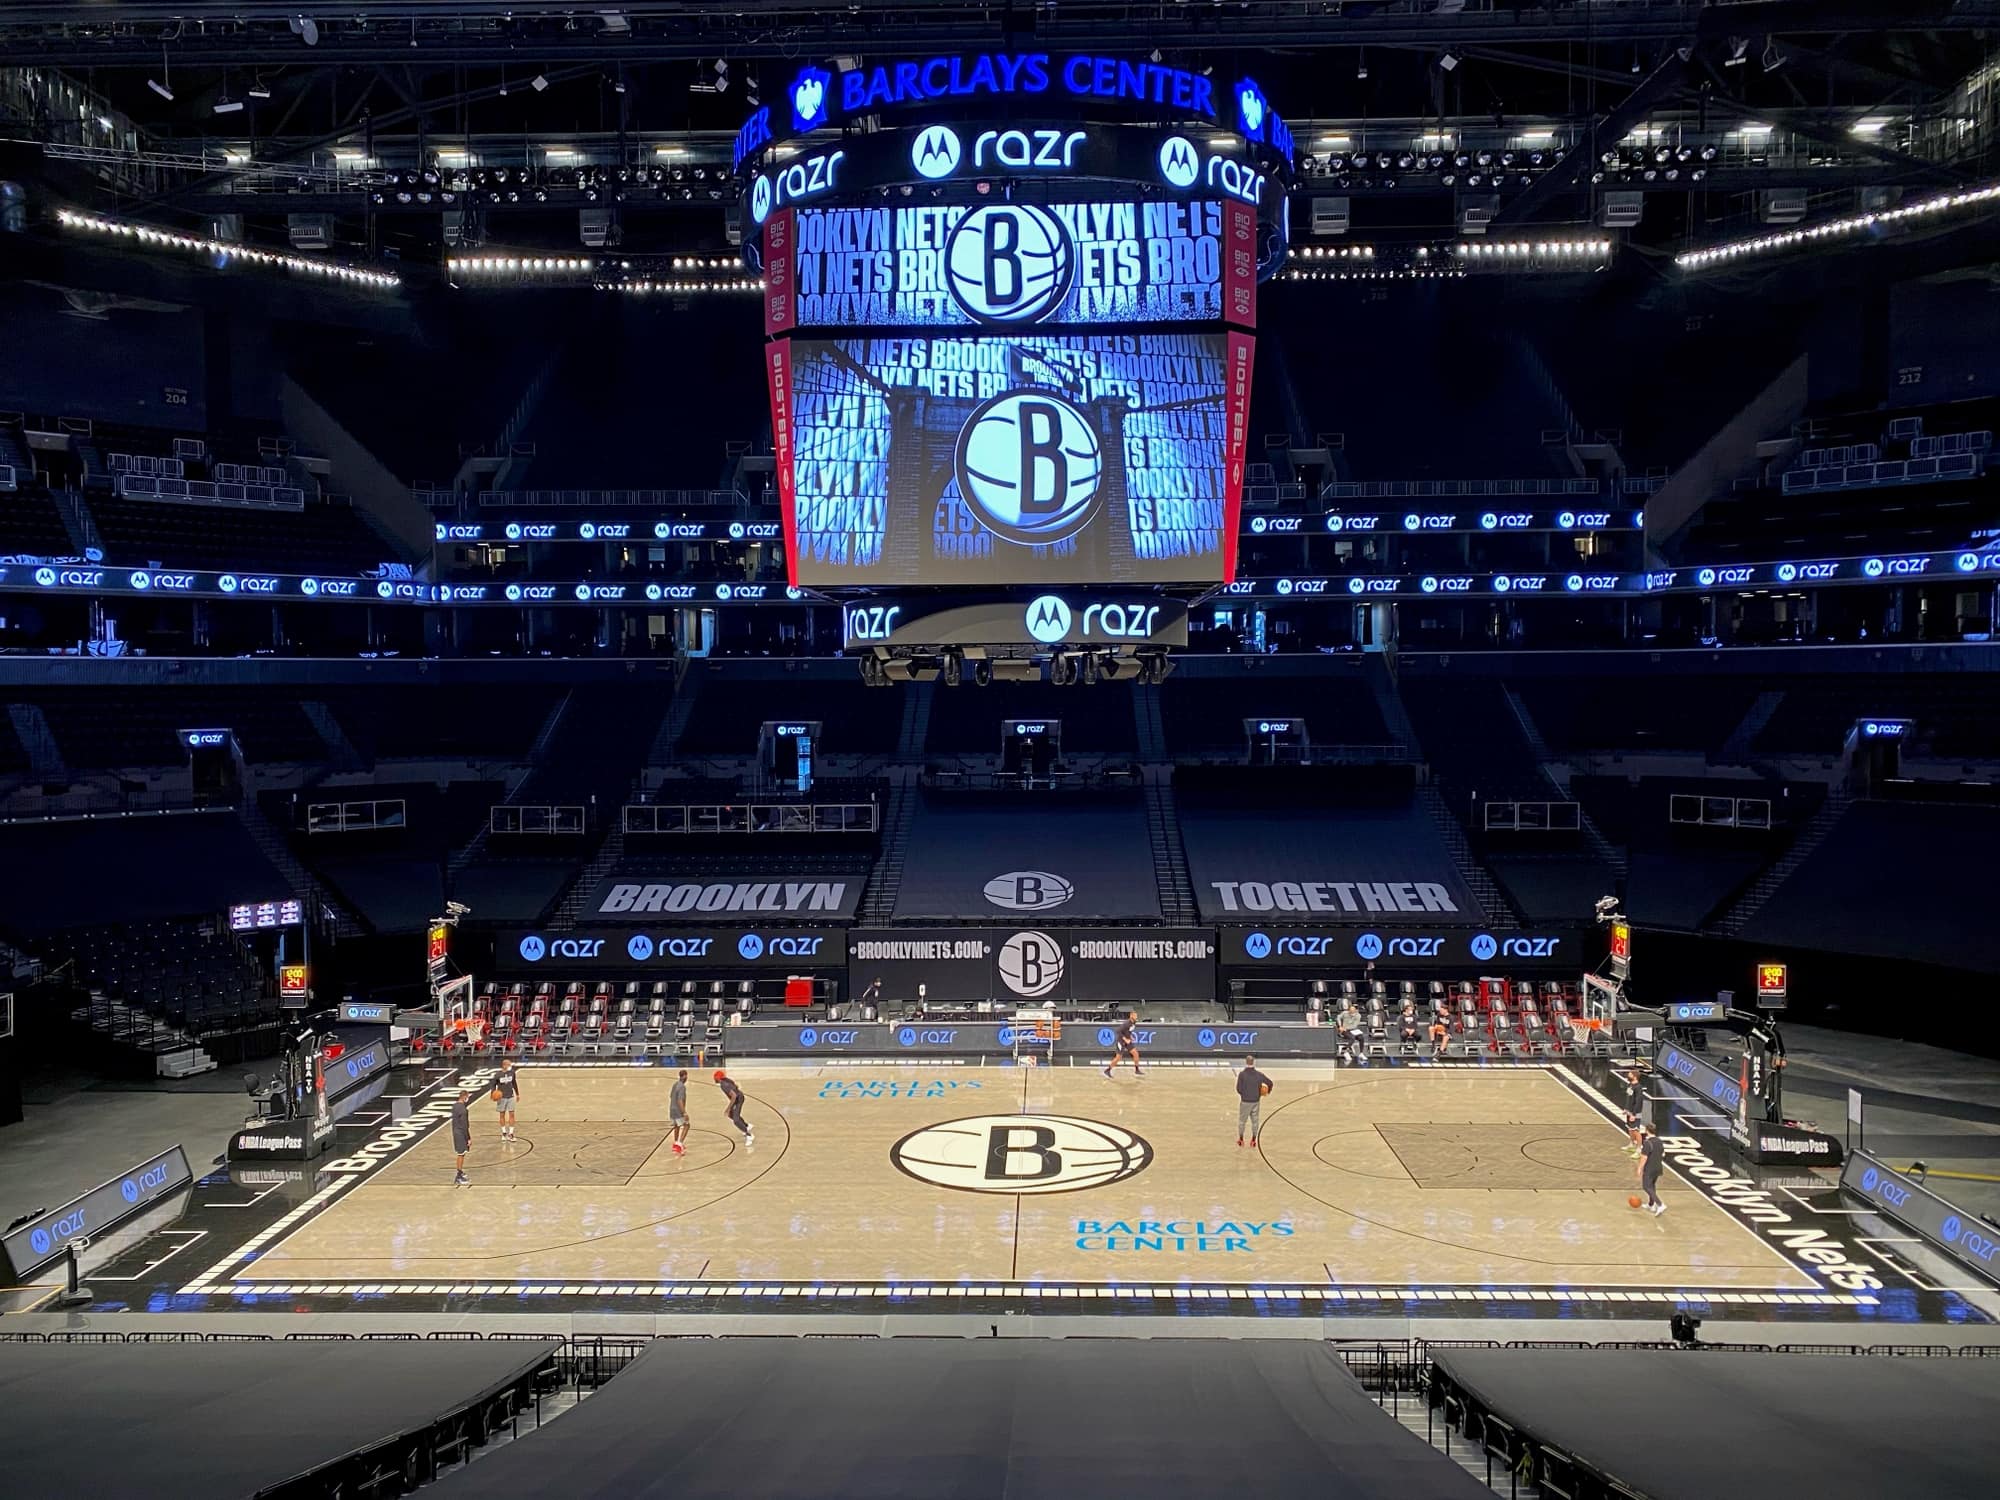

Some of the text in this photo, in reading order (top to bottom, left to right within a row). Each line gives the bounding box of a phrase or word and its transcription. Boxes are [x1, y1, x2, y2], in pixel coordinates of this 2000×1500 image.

[843, 54, 1217, 117] BARCLAYS CENTER
[974, 130, 1087, 167] razr
[776, 151, 843, 205] razr
[1207, 155, 1265, 204] razr
[1149, 235, 1220, 285] BRO
[825, 251, 892, 294] NETS
[869, 338, 926, 367] NETS
[1101, 351, 1199, 384] BROOKLYN
[165, 393, 187, 405] 204
[1232, 346, 1247, 456] BIOSTEEL
[773, 353, 788, 462] BIOSTEEL
[1269, 517, 1303, 531] razr
[1346, 516, 1379, 530] razr
[1422, 515, 1456, 529] razr
[1500, 513, 1533, 528] razr
[1577, 512, 1611, 527] razr
[449, 525, 481, 537] razr
[523, 524, 556, 537] razr
[598, 524, 630, 536] razr
[673, 523, 705, 536] razr
[747, 523, 779, 536] razr
[1800, 563, 1840, 578] razr
[1888, 558, 1930, 574] razr
[60, 571, 103, 585] razr
[154, 574, 194, 589] razr
[1585, 575, 1619, 590] razr
[1718, 567, 1755, 583] razr
[240, 577, 278, 592] razr
[321, 580, 356, 594] razr
[1295, 579, 1328, 593] razr
[1366, 578, 1400, 593] razr
[1440, 577, 1474, 592] razr
[1512, 576, 1546, 591] razr
[453, 586, 486, 599] razr
[523, 586, 556, 598] razr
[593, 586, 626, 598] razr
[663, 585, 696, 598] razr
[734, 585, 767, 598] razr
[850, 606, 900, 640] razr
[1082, 603, 1160, 637] razr
[787, 726, 806, 735] razr
[1026, 724, 1046, 733] razr
[1270, 722, 1290, 731] razr
[1878, 724, 1903, 734] razr
[201, 734, 223, 744] razr
[599, 883, 847, 913] BROOKLYN
[1211, 881, 1459, 912] TOGETHER
[550, 937, 606, 958] razr
[658, 937, 713, 958] razr
[768, 936, 824, 957] razr
[857, 941, 983, 960] BROOKLYNNETS.COM
[1079, 940, 1206, 960] BROOKLYNNETS.COM
[1276, 936, 1334, 957] razr
[1388, 937, 1446, 957] razr
[1503, 937, 1560, 957] razr
[360, 1008, 382, 1017] razr
[1691, 1007, 1715, 1016] razr
[821, 1030, 859, 1044] razr
[920, 1030, 958, 1044] razr
[1219, 1031, 1258, 1045] razr
[823, 1080, 983, 1089] BARCLAYS
[818, 1089, 946, 1098] CENTER
[284, 1136, 303, 1149] Pass
[320, 1098, 456, 1172] Brooklyn
[984, 1125, 1063, 1181] B
[1809, 1138, 1829, 1153] Pass
[139, 1163, 167, 1192] razr
[1878, 1179, 1912, 1208] razr
[1660, 1136, 1884, 1290] Brooklyn Nets
[51, 1208, 85, 1241] razr
[1074, 1219, 1296, 1237] BARCLAYS
[1074, 1236, 1256, 1253] CENTER
[1960, 1230, 2000, 1262] razr
